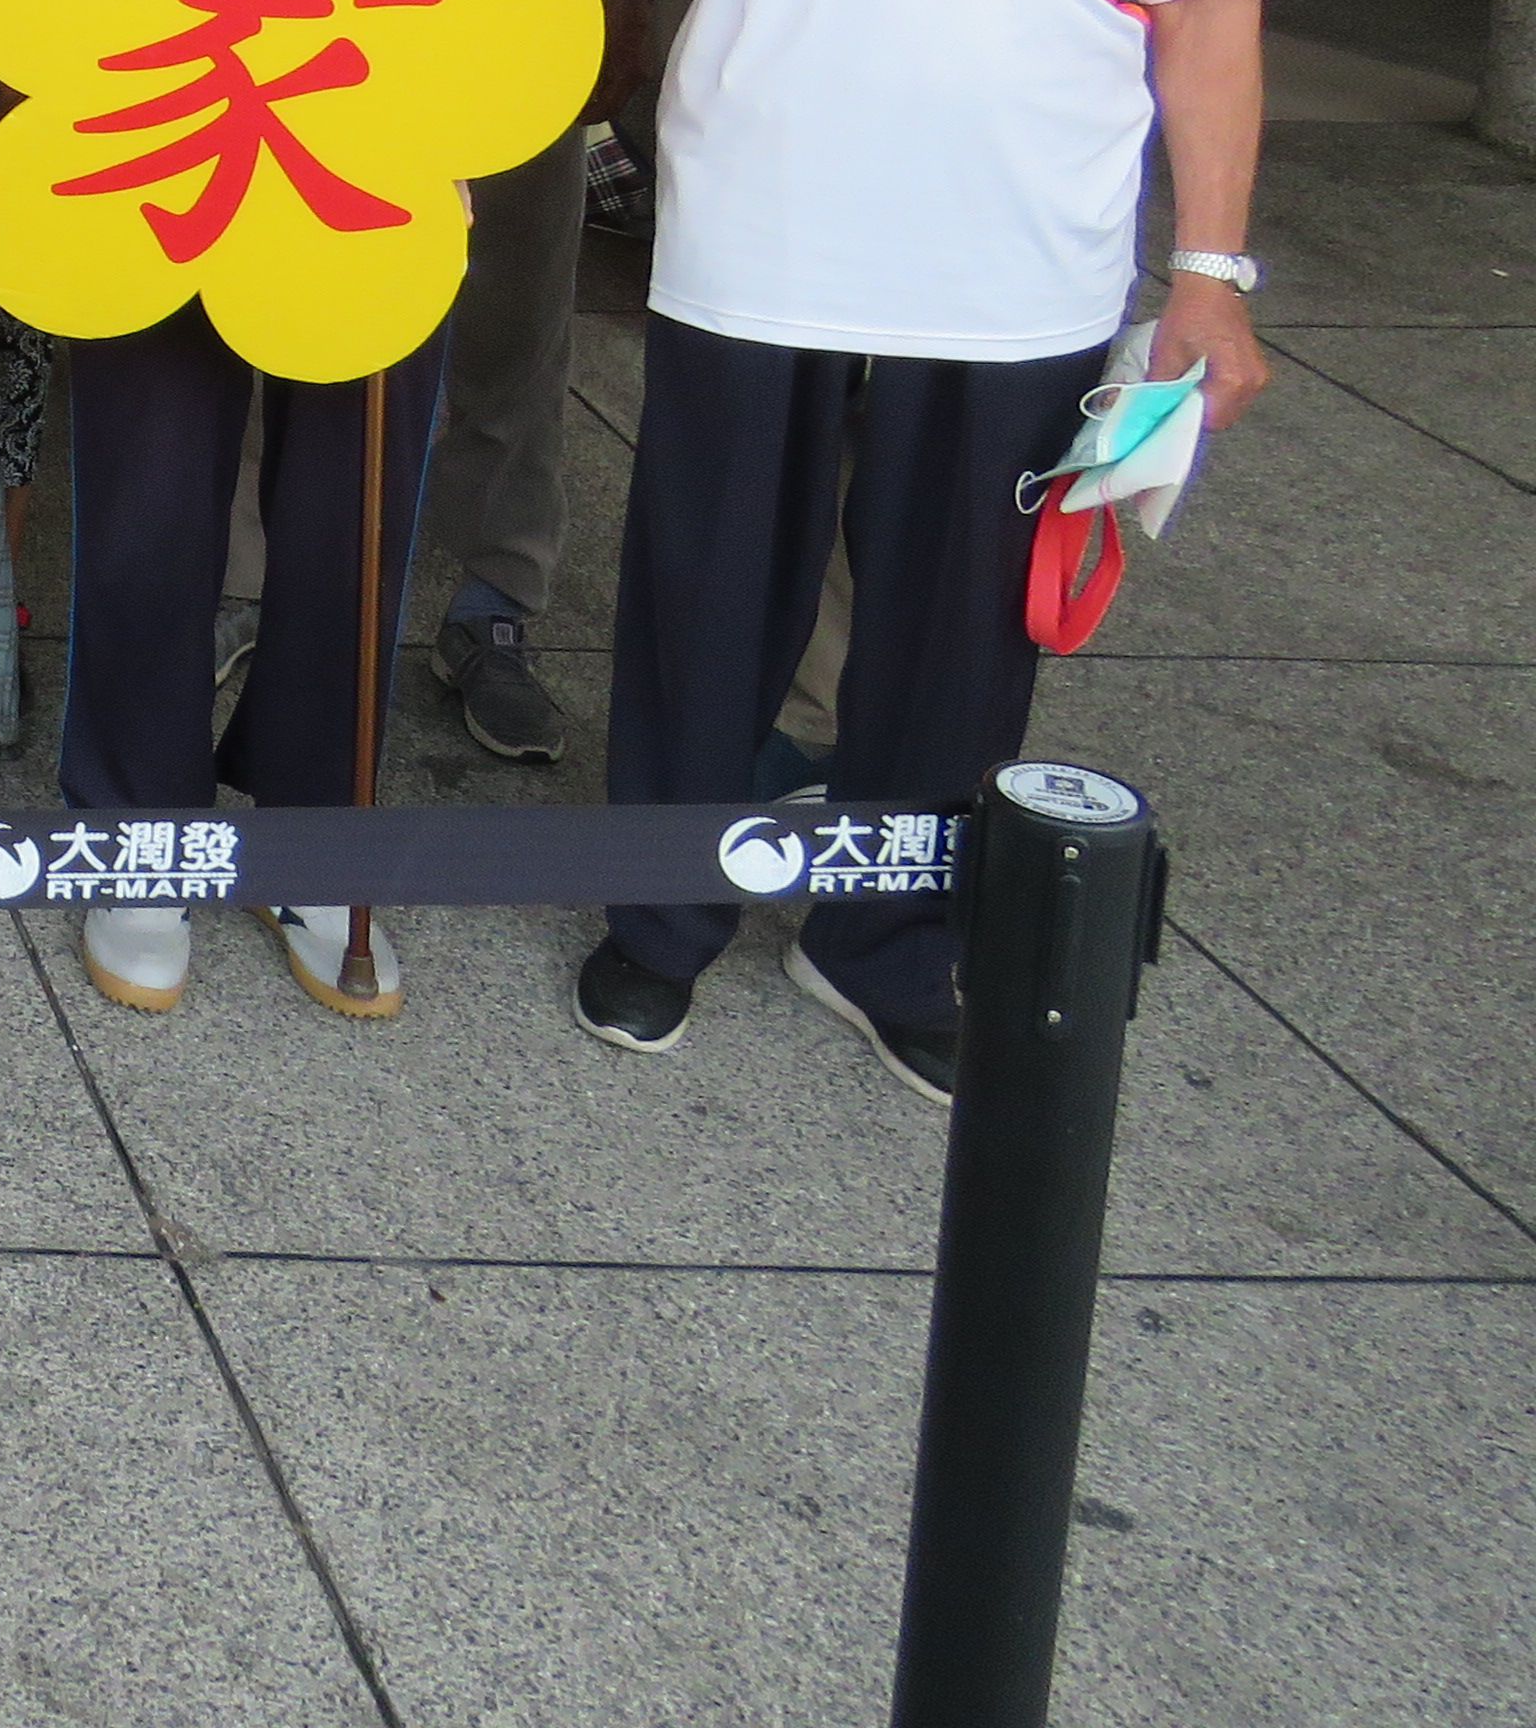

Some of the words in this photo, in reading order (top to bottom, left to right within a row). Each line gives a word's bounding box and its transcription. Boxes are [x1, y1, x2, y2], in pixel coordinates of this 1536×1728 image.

[47, 821, 239, 873] 大潤發
[46, 878, 236, 900] RT-MART
